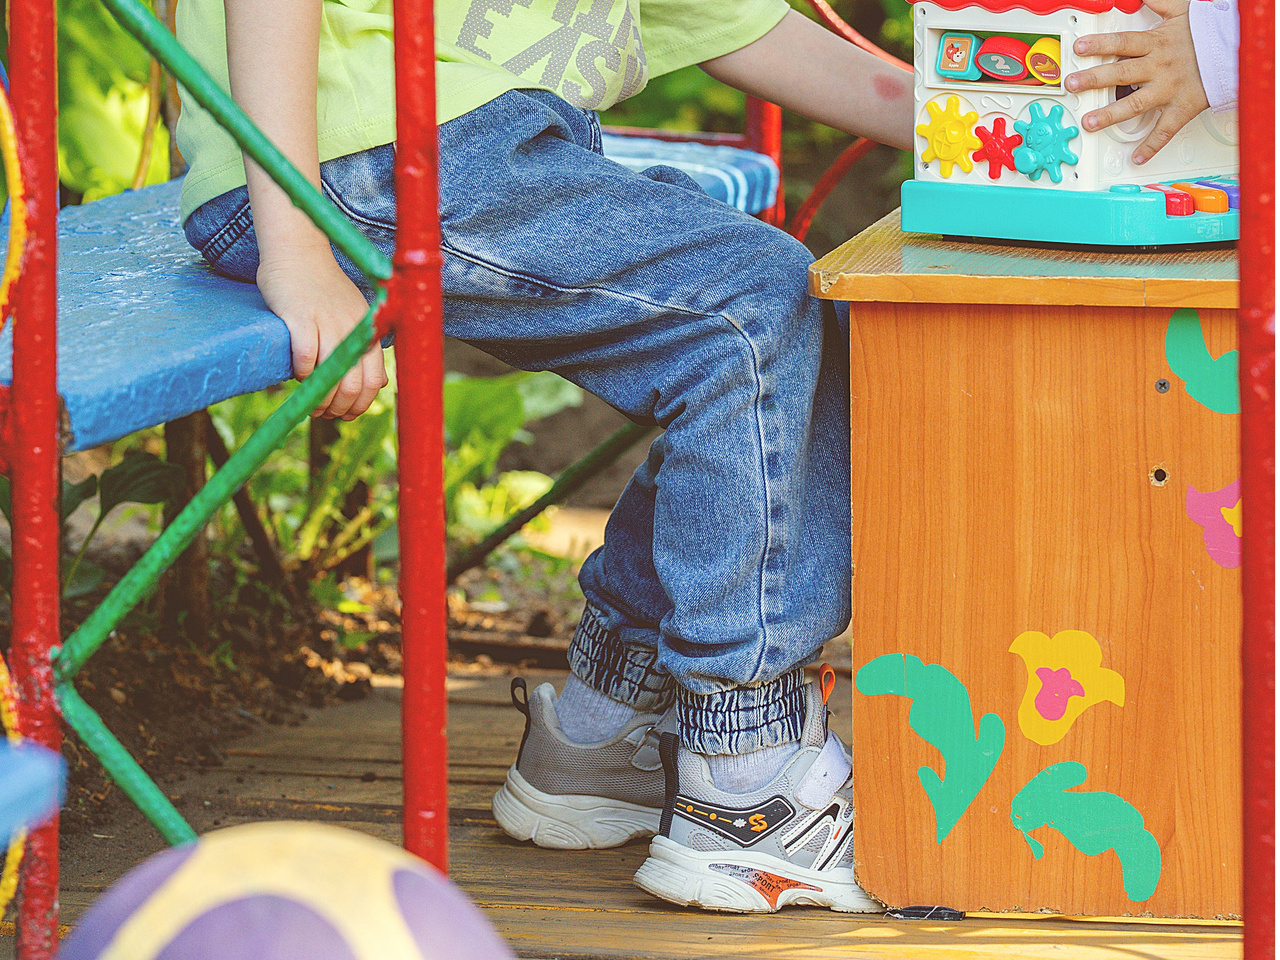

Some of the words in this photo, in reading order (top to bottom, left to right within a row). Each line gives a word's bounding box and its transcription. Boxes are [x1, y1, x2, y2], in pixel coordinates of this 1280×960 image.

[990, 55, 1011, 70] 2
[752, 872, 776, 893] SPORT
[762, 871, 775, 884] SPORT
